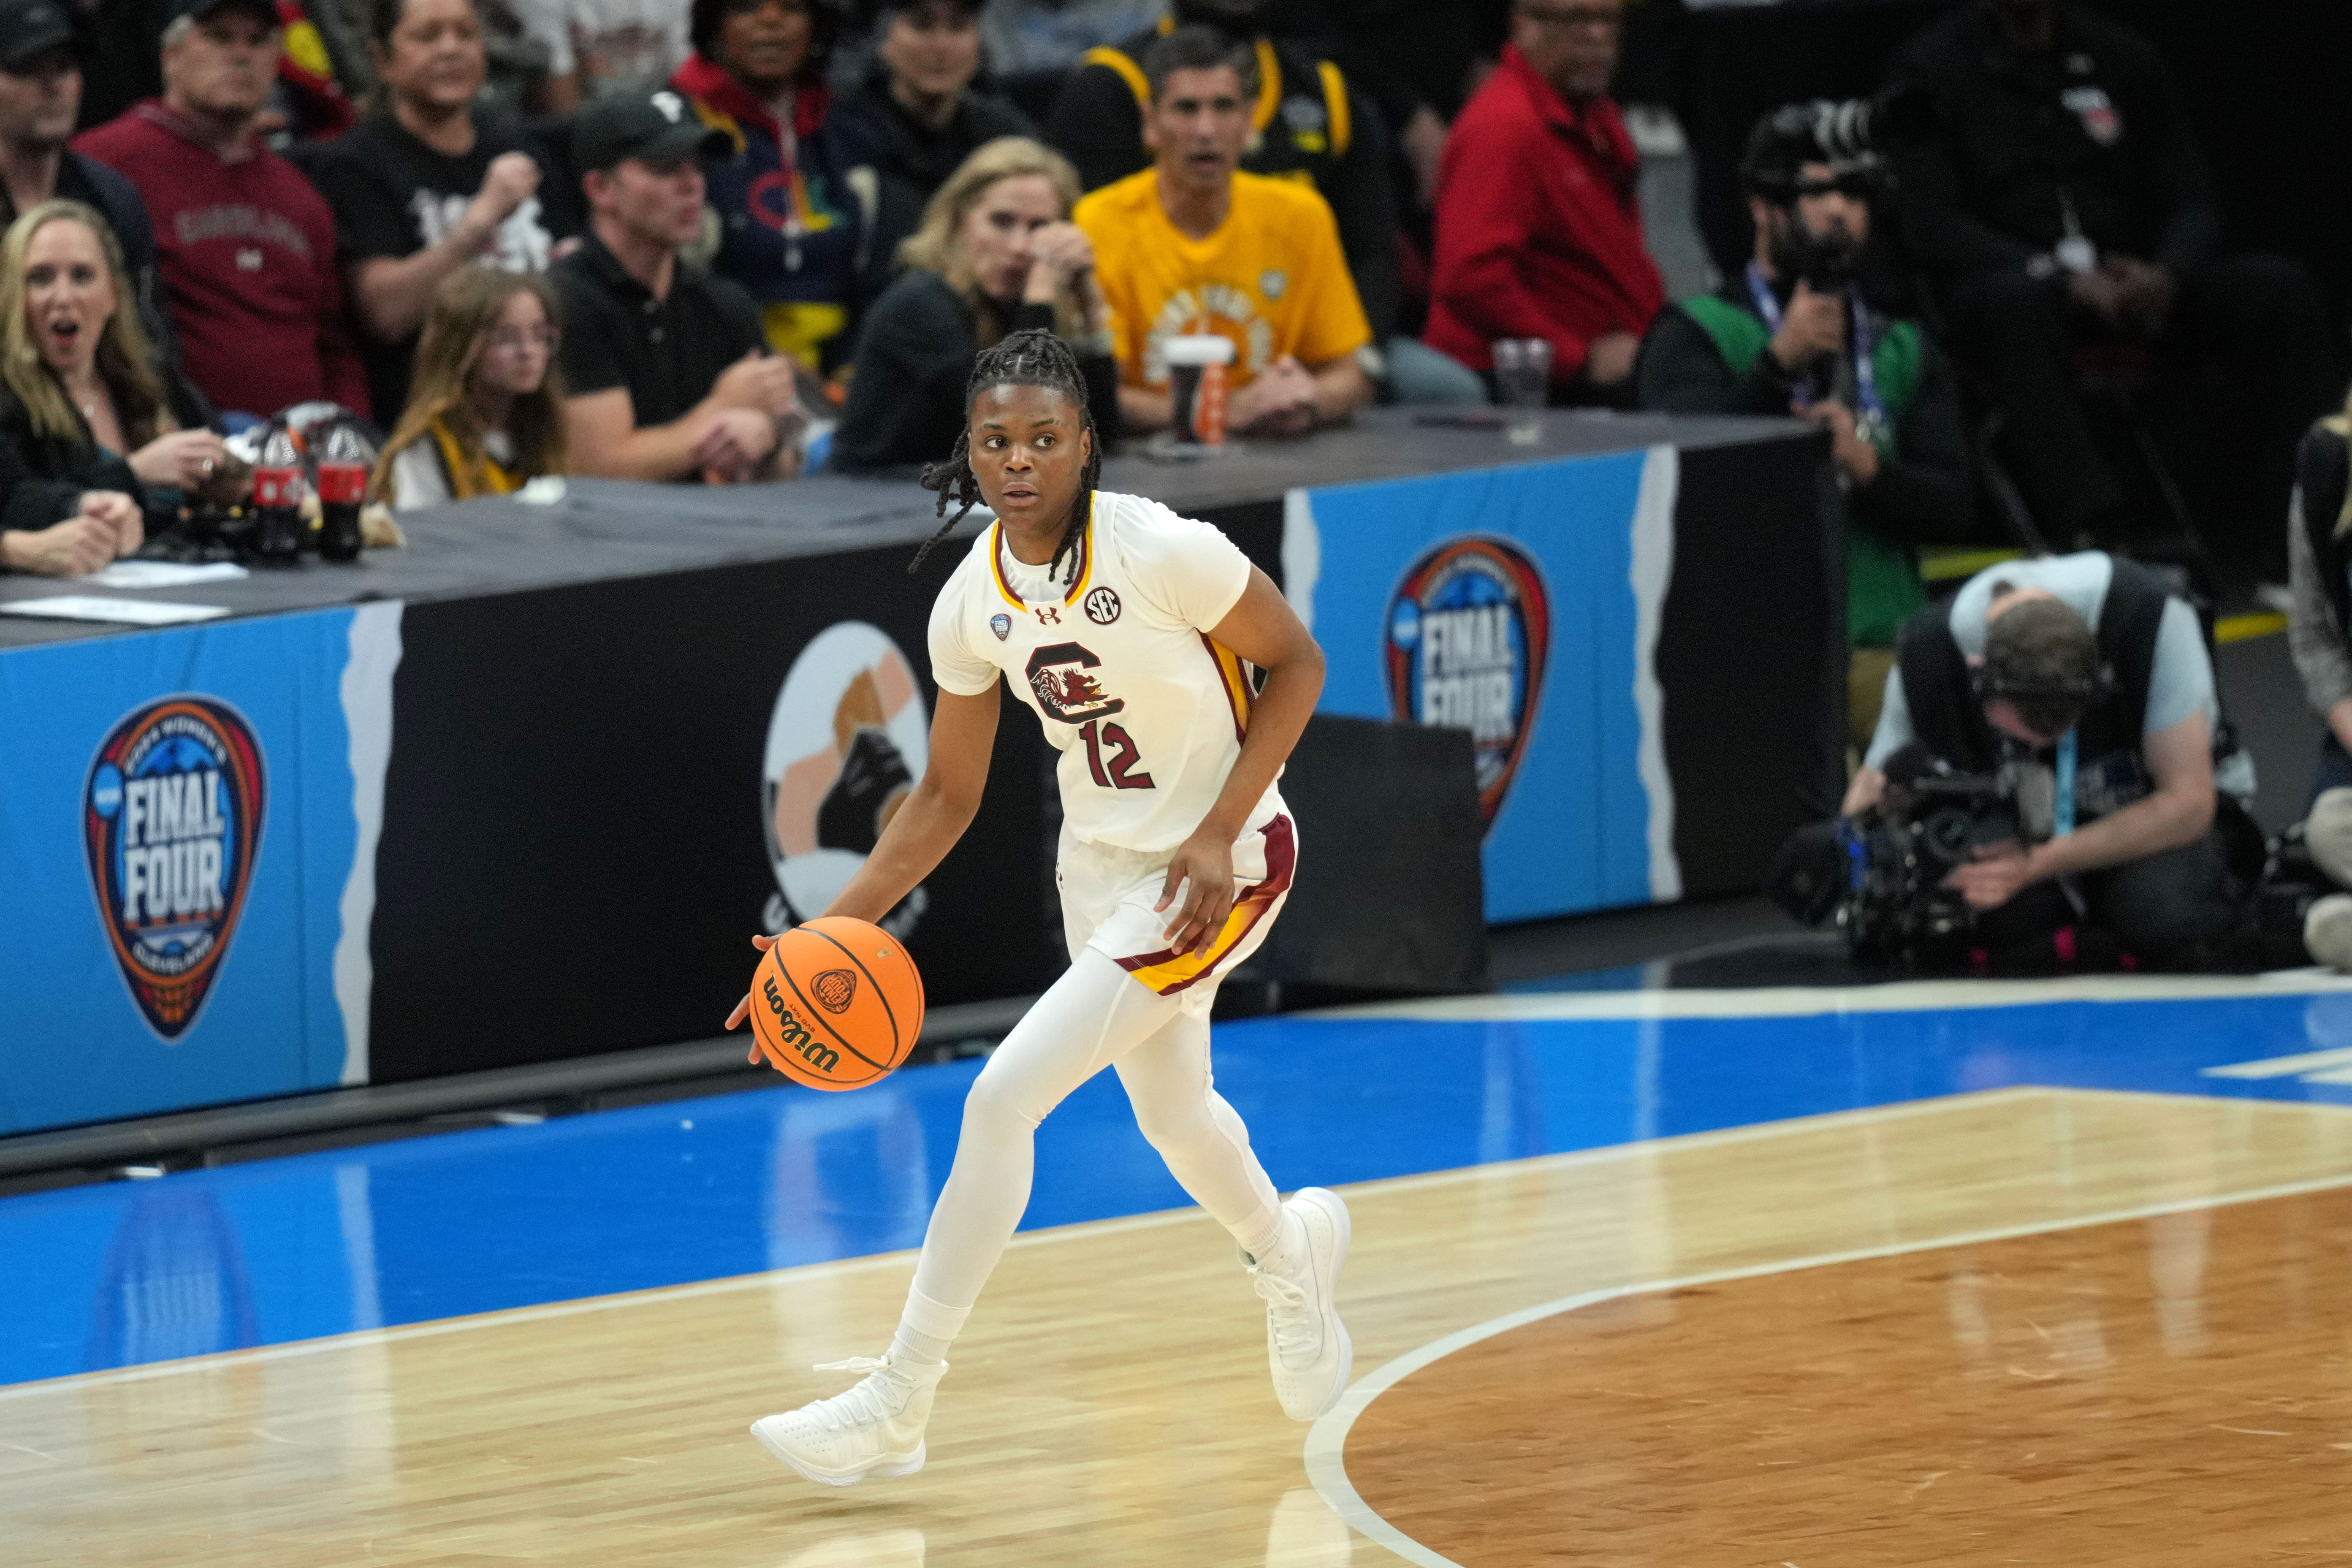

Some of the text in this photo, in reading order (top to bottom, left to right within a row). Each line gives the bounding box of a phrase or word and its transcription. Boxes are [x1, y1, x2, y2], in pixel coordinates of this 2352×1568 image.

[1087, 589, 1119, 622] SEC
[1423, 604, 1513, 681] FINAL
[1078, 719, 1156, 789] 12
[125, 770, 225, 845] FINAL
[123, 838, 224, 922] FOUR
[789, 1004, 816, 1033] EVO NXT
[820, 979, 841, 1005] FINAL
[826, 974, 850, 999] FOUR
[763, 974, 840, 1074] Wilson
